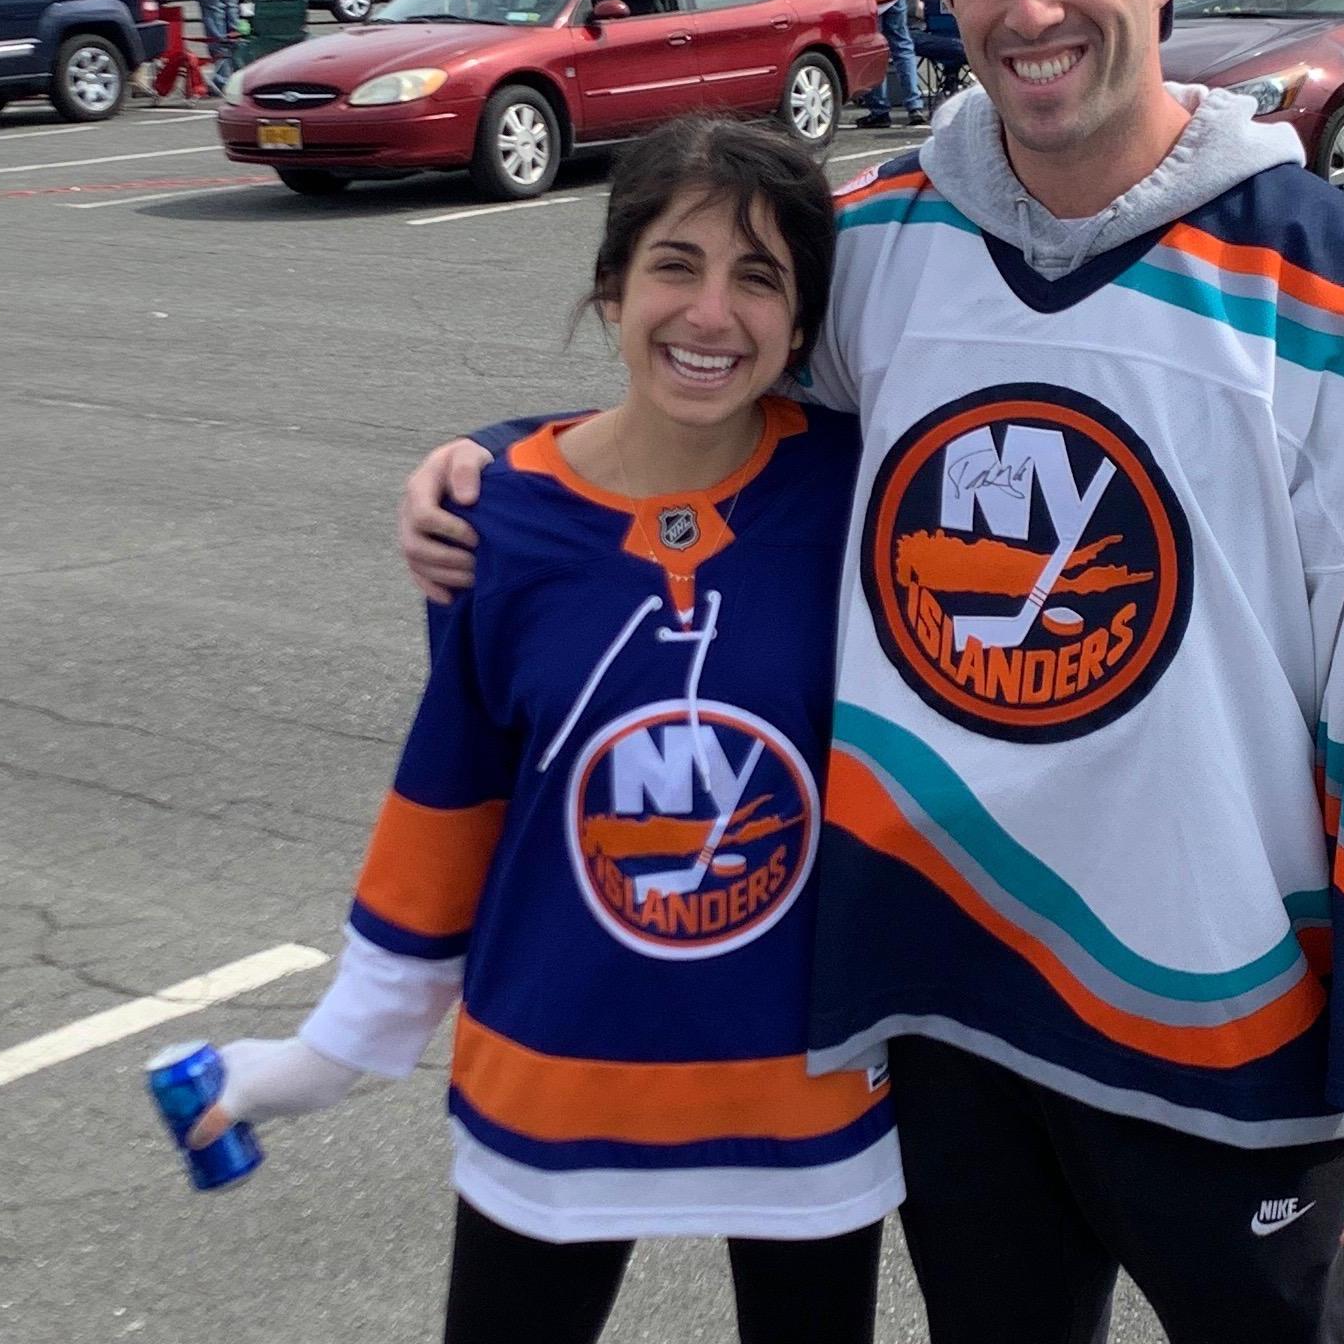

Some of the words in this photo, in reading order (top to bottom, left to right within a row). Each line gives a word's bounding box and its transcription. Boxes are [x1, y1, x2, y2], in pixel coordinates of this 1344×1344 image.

[904, 578, 1137, 704] ISLANDERS
[593, 844, 788, 935] ISLANDERS
[1259, 1197, 1299, 1221] NIKE
